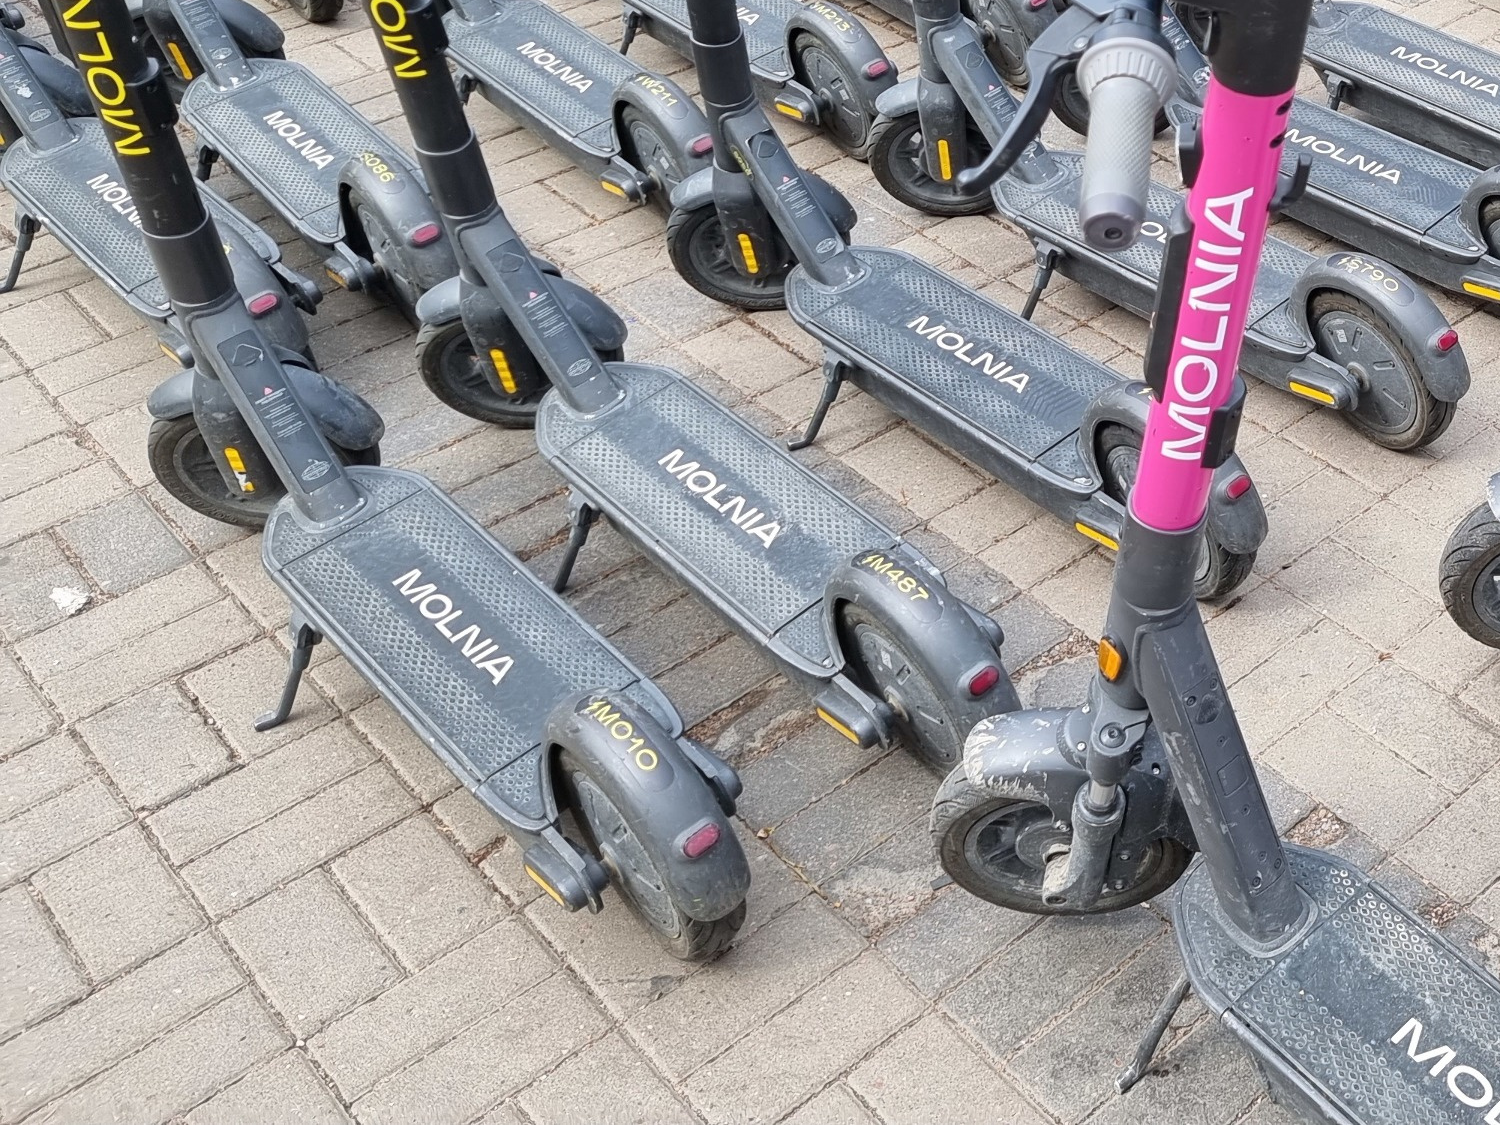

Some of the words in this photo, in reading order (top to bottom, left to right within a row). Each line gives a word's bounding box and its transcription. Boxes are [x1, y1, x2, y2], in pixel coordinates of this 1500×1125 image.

[516, 42, 593, 94] MOLNIA
[1390, 45, 1500, 98] MOLNIA
[263, 110, 335, 171] MOLNIA
[1284, 128, 1402, 185] MOLNIA
[1350, 258, 1398, 293] S790
[1161, 186, 1255, 463] MOLNIA
[906, 313, 1031, 396] MOLNIA
[657, 448, 784, 550] MOLNIA
[872, 553, 931, 603] M487
[390, 568, 515, 687] MOLNIA
